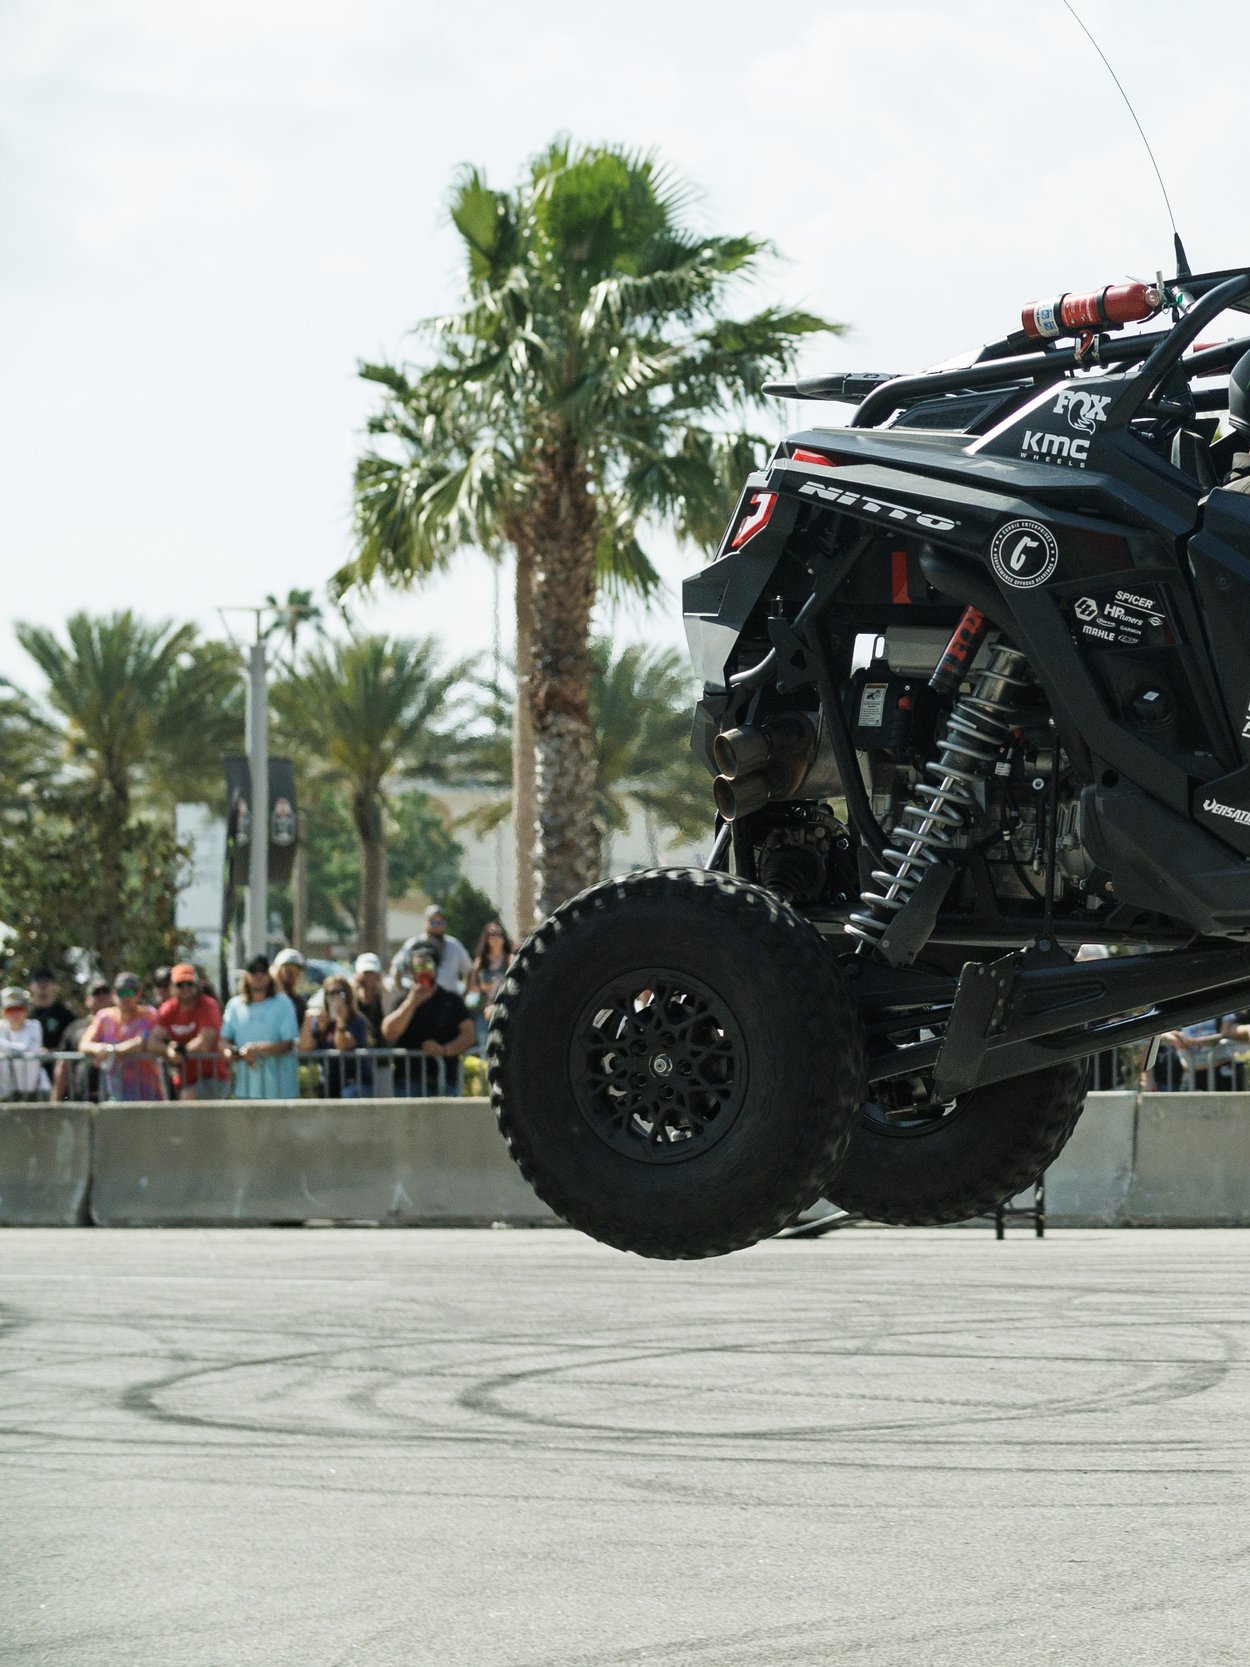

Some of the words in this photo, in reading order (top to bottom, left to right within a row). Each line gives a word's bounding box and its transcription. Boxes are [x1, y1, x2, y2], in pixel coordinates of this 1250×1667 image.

[1053, 389, 1112, 435] FOX
[1022, 430, 1091, 460] KMC
[1020, 452, 1085, 468] WHEELS
[798, 481, 956, 531] NITTO
[1115, 590, 1154, 609] SPICER
[1082, 625, 1116, 641] MAHLE
